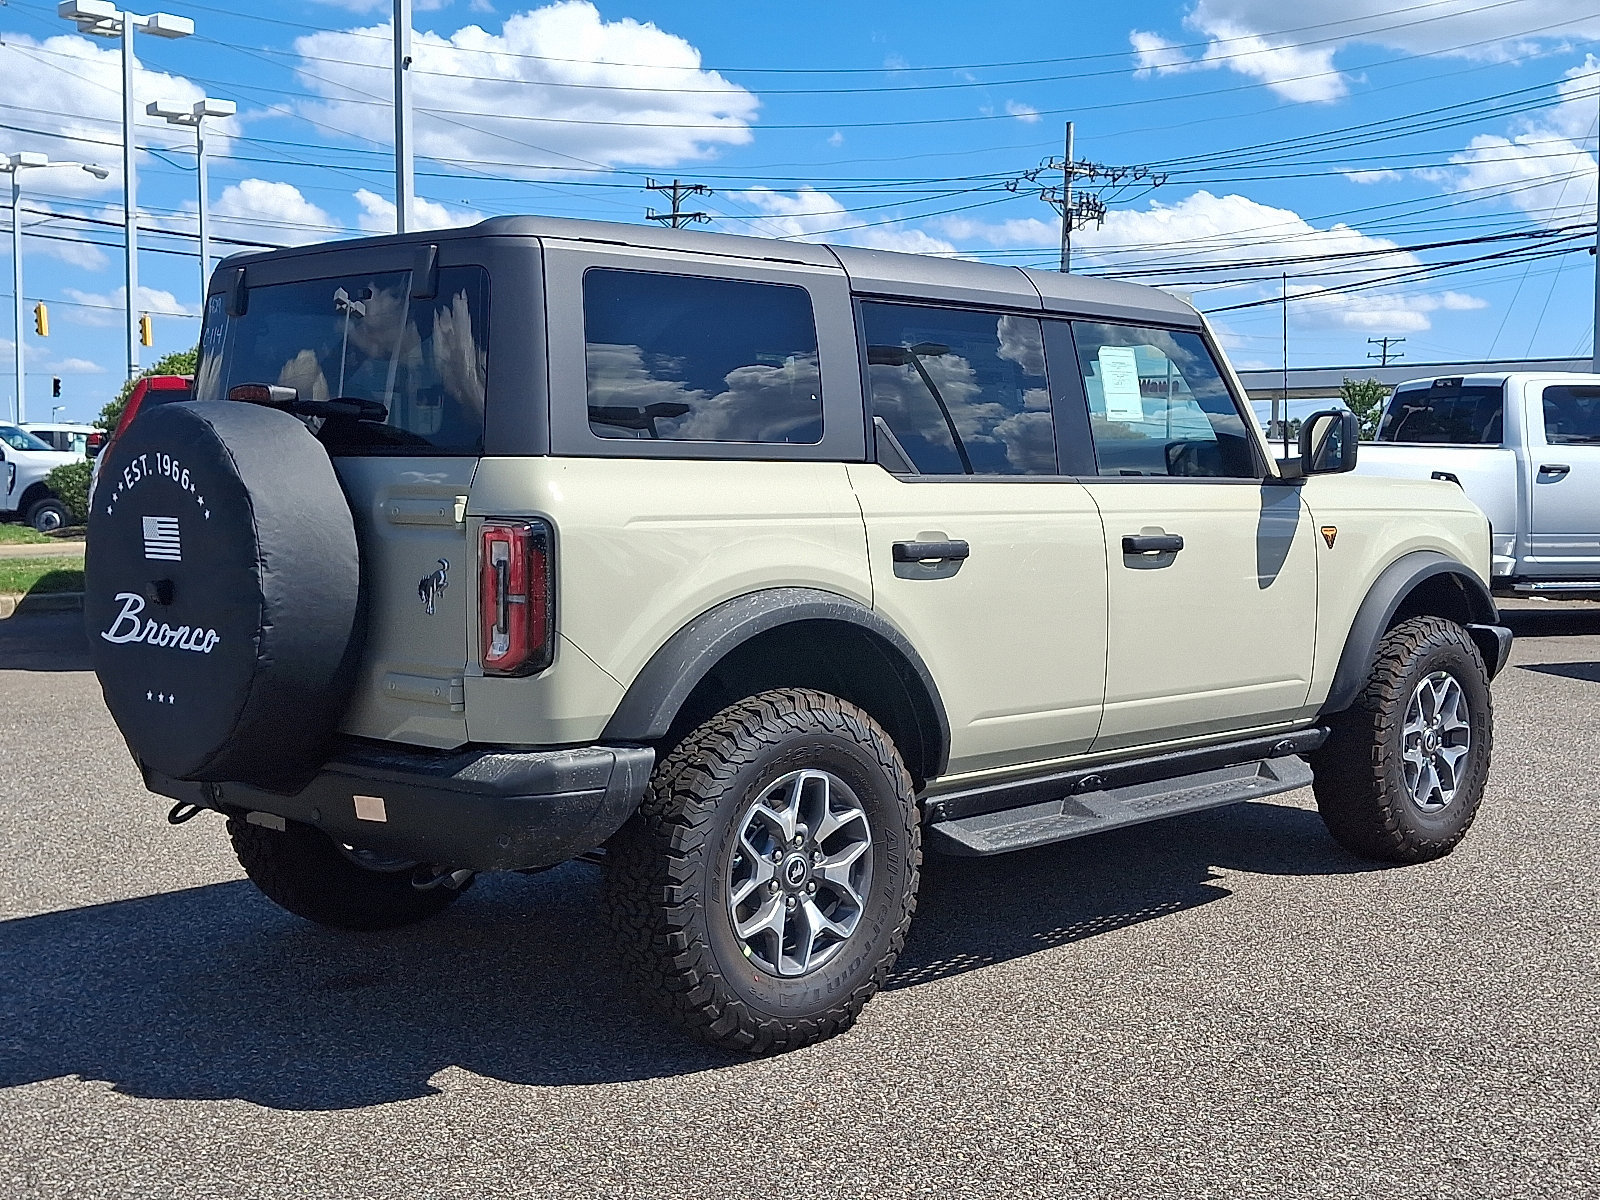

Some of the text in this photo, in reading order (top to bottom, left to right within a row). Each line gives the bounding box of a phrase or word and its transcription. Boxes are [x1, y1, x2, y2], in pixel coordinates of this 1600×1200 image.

[124, 452, 190, 490] EST. 1966
[101, 592, 220, 653] Bronco
